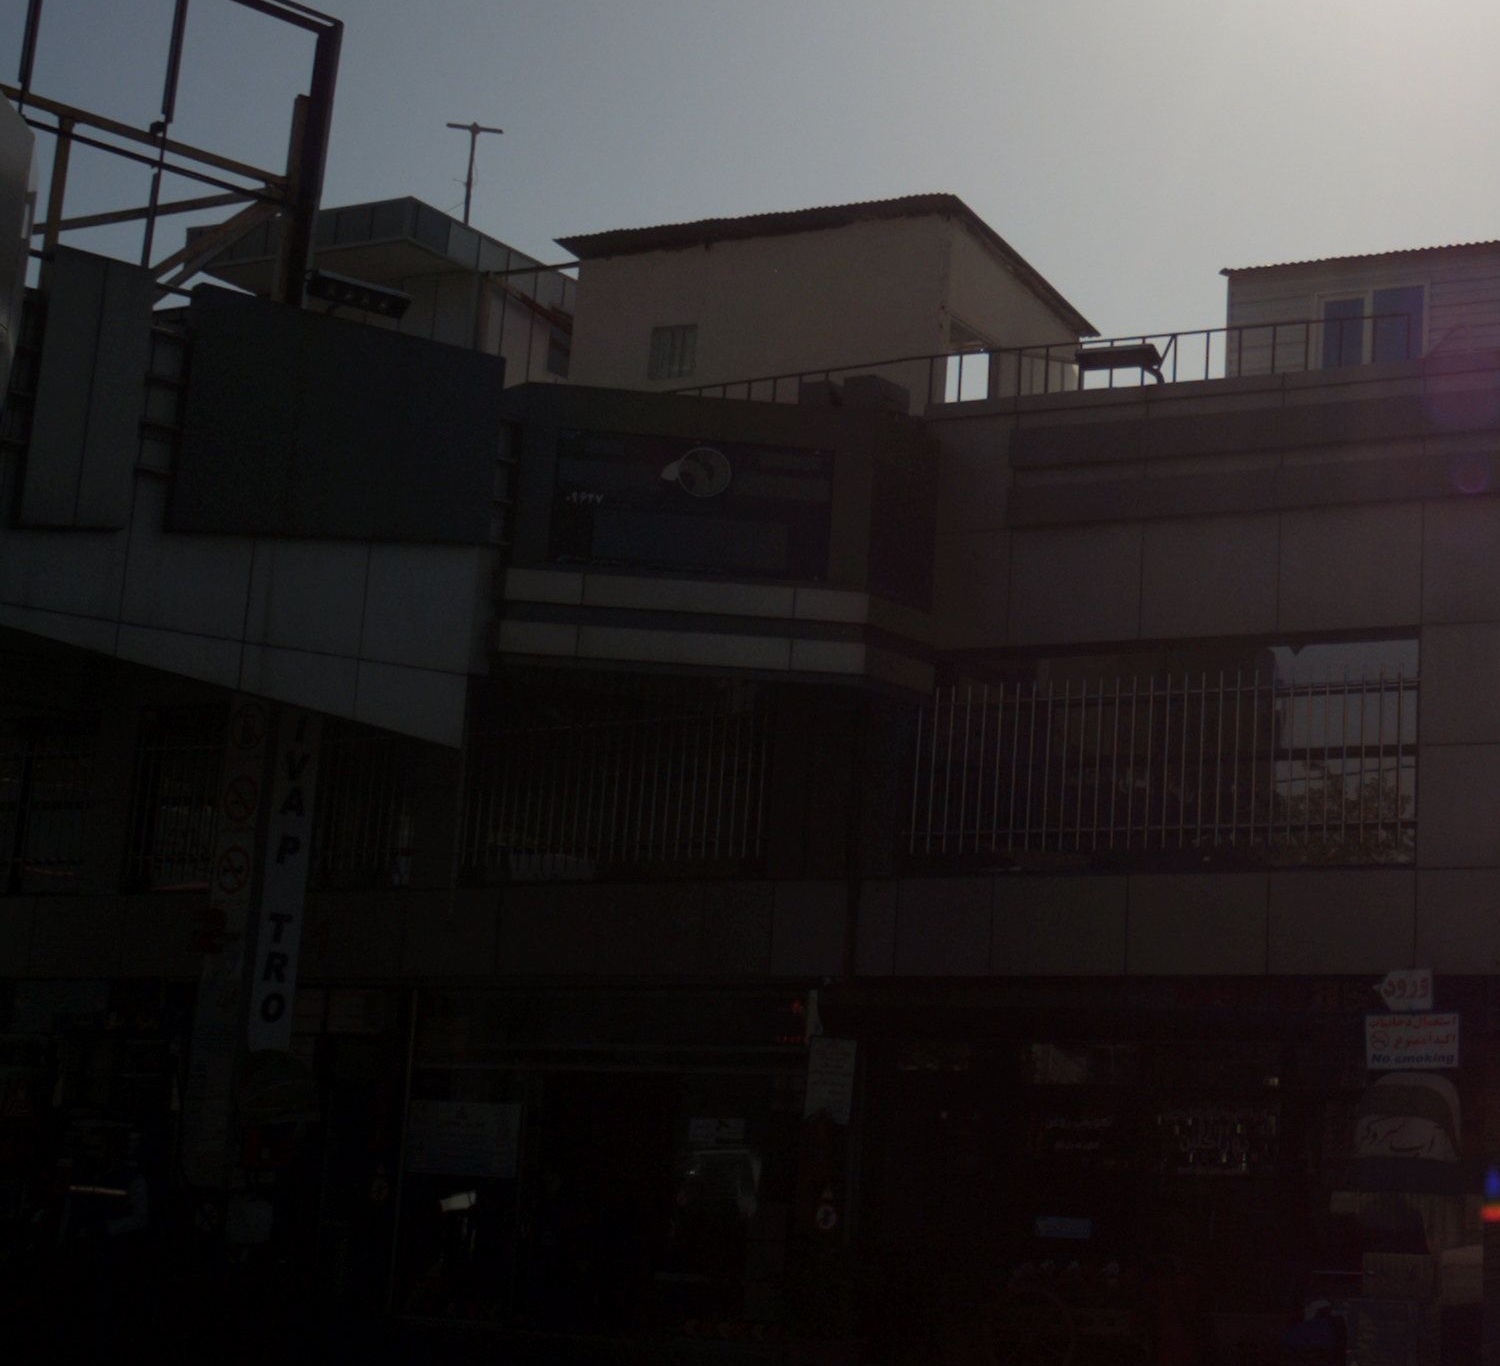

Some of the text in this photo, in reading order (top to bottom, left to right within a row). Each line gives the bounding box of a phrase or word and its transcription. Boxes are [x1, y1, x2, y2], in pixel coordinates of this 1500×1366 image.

[1383, 977, 1430, 999] ورود
[1371, 1051, 1455, 1065] No smoking
